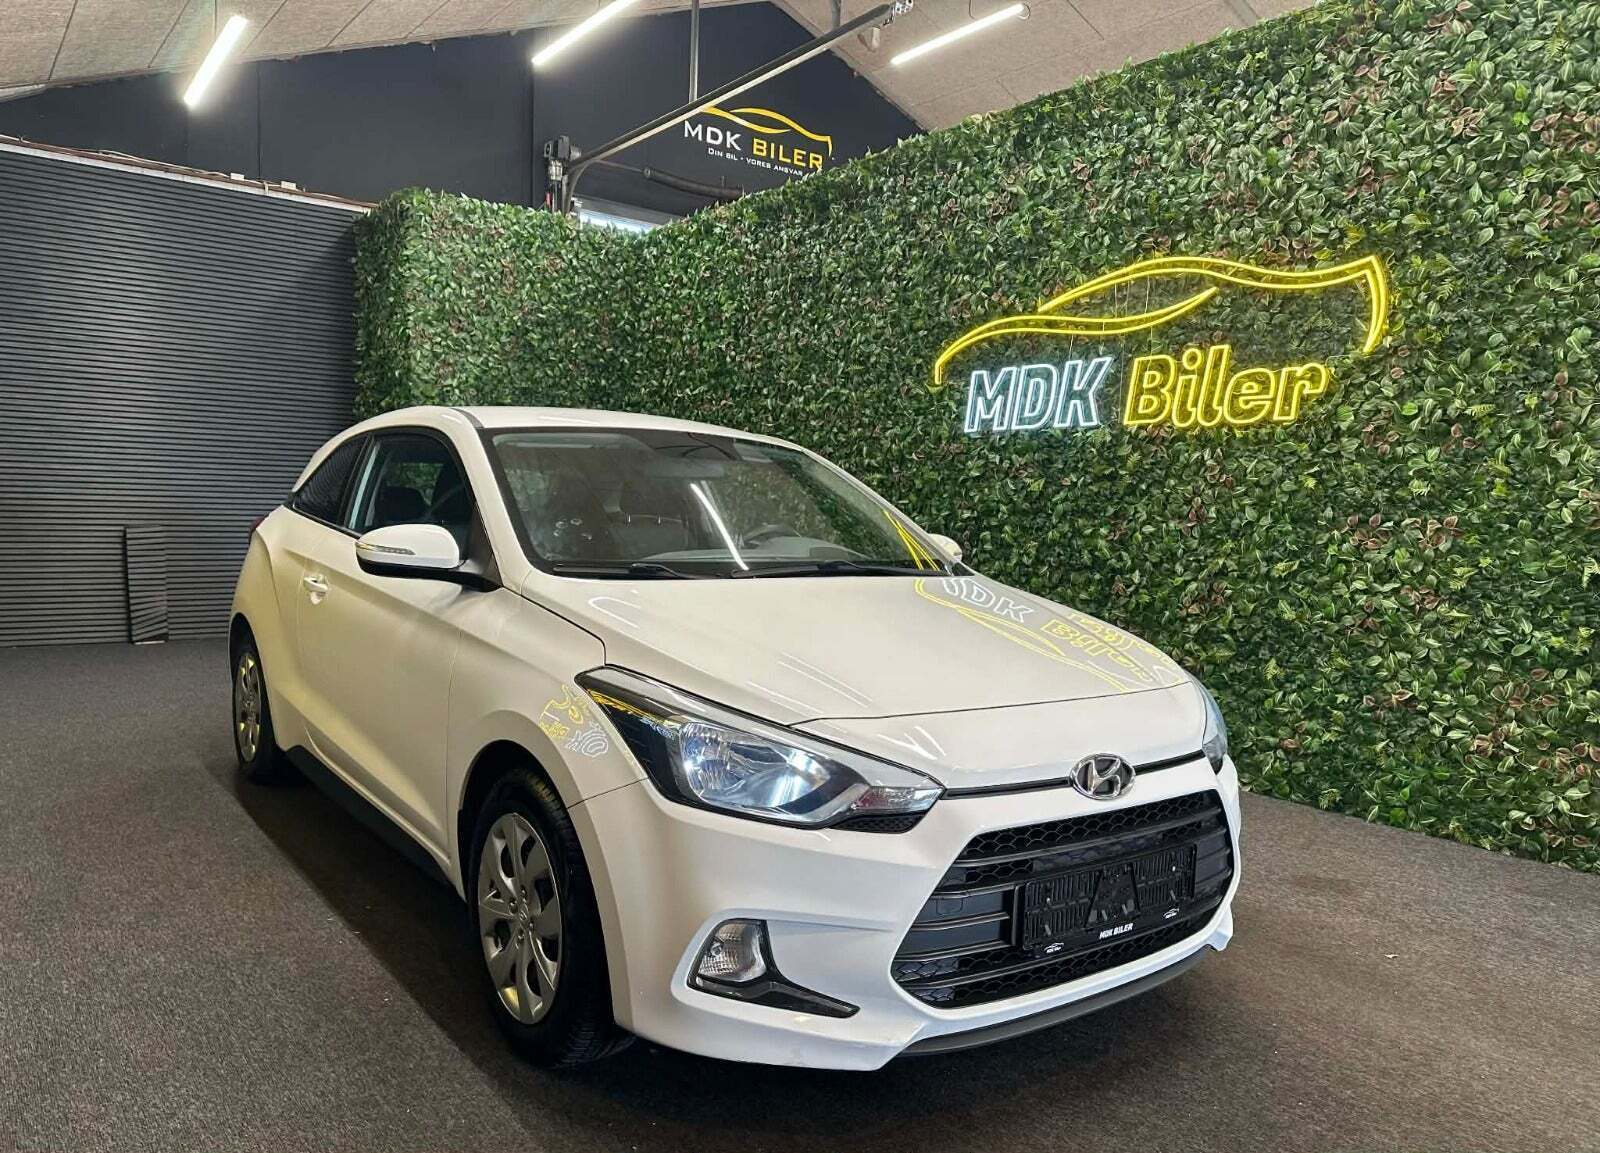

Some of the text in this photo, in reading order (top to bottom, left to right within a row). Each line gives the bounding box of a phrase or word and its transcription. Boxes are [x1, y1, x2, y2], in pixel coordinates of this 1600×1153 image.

[684, 120, 822, 168] MDK BILER
[963, 345, 1328, 433] MDK Biler
[1114, 923, 1133, 935] BILER
